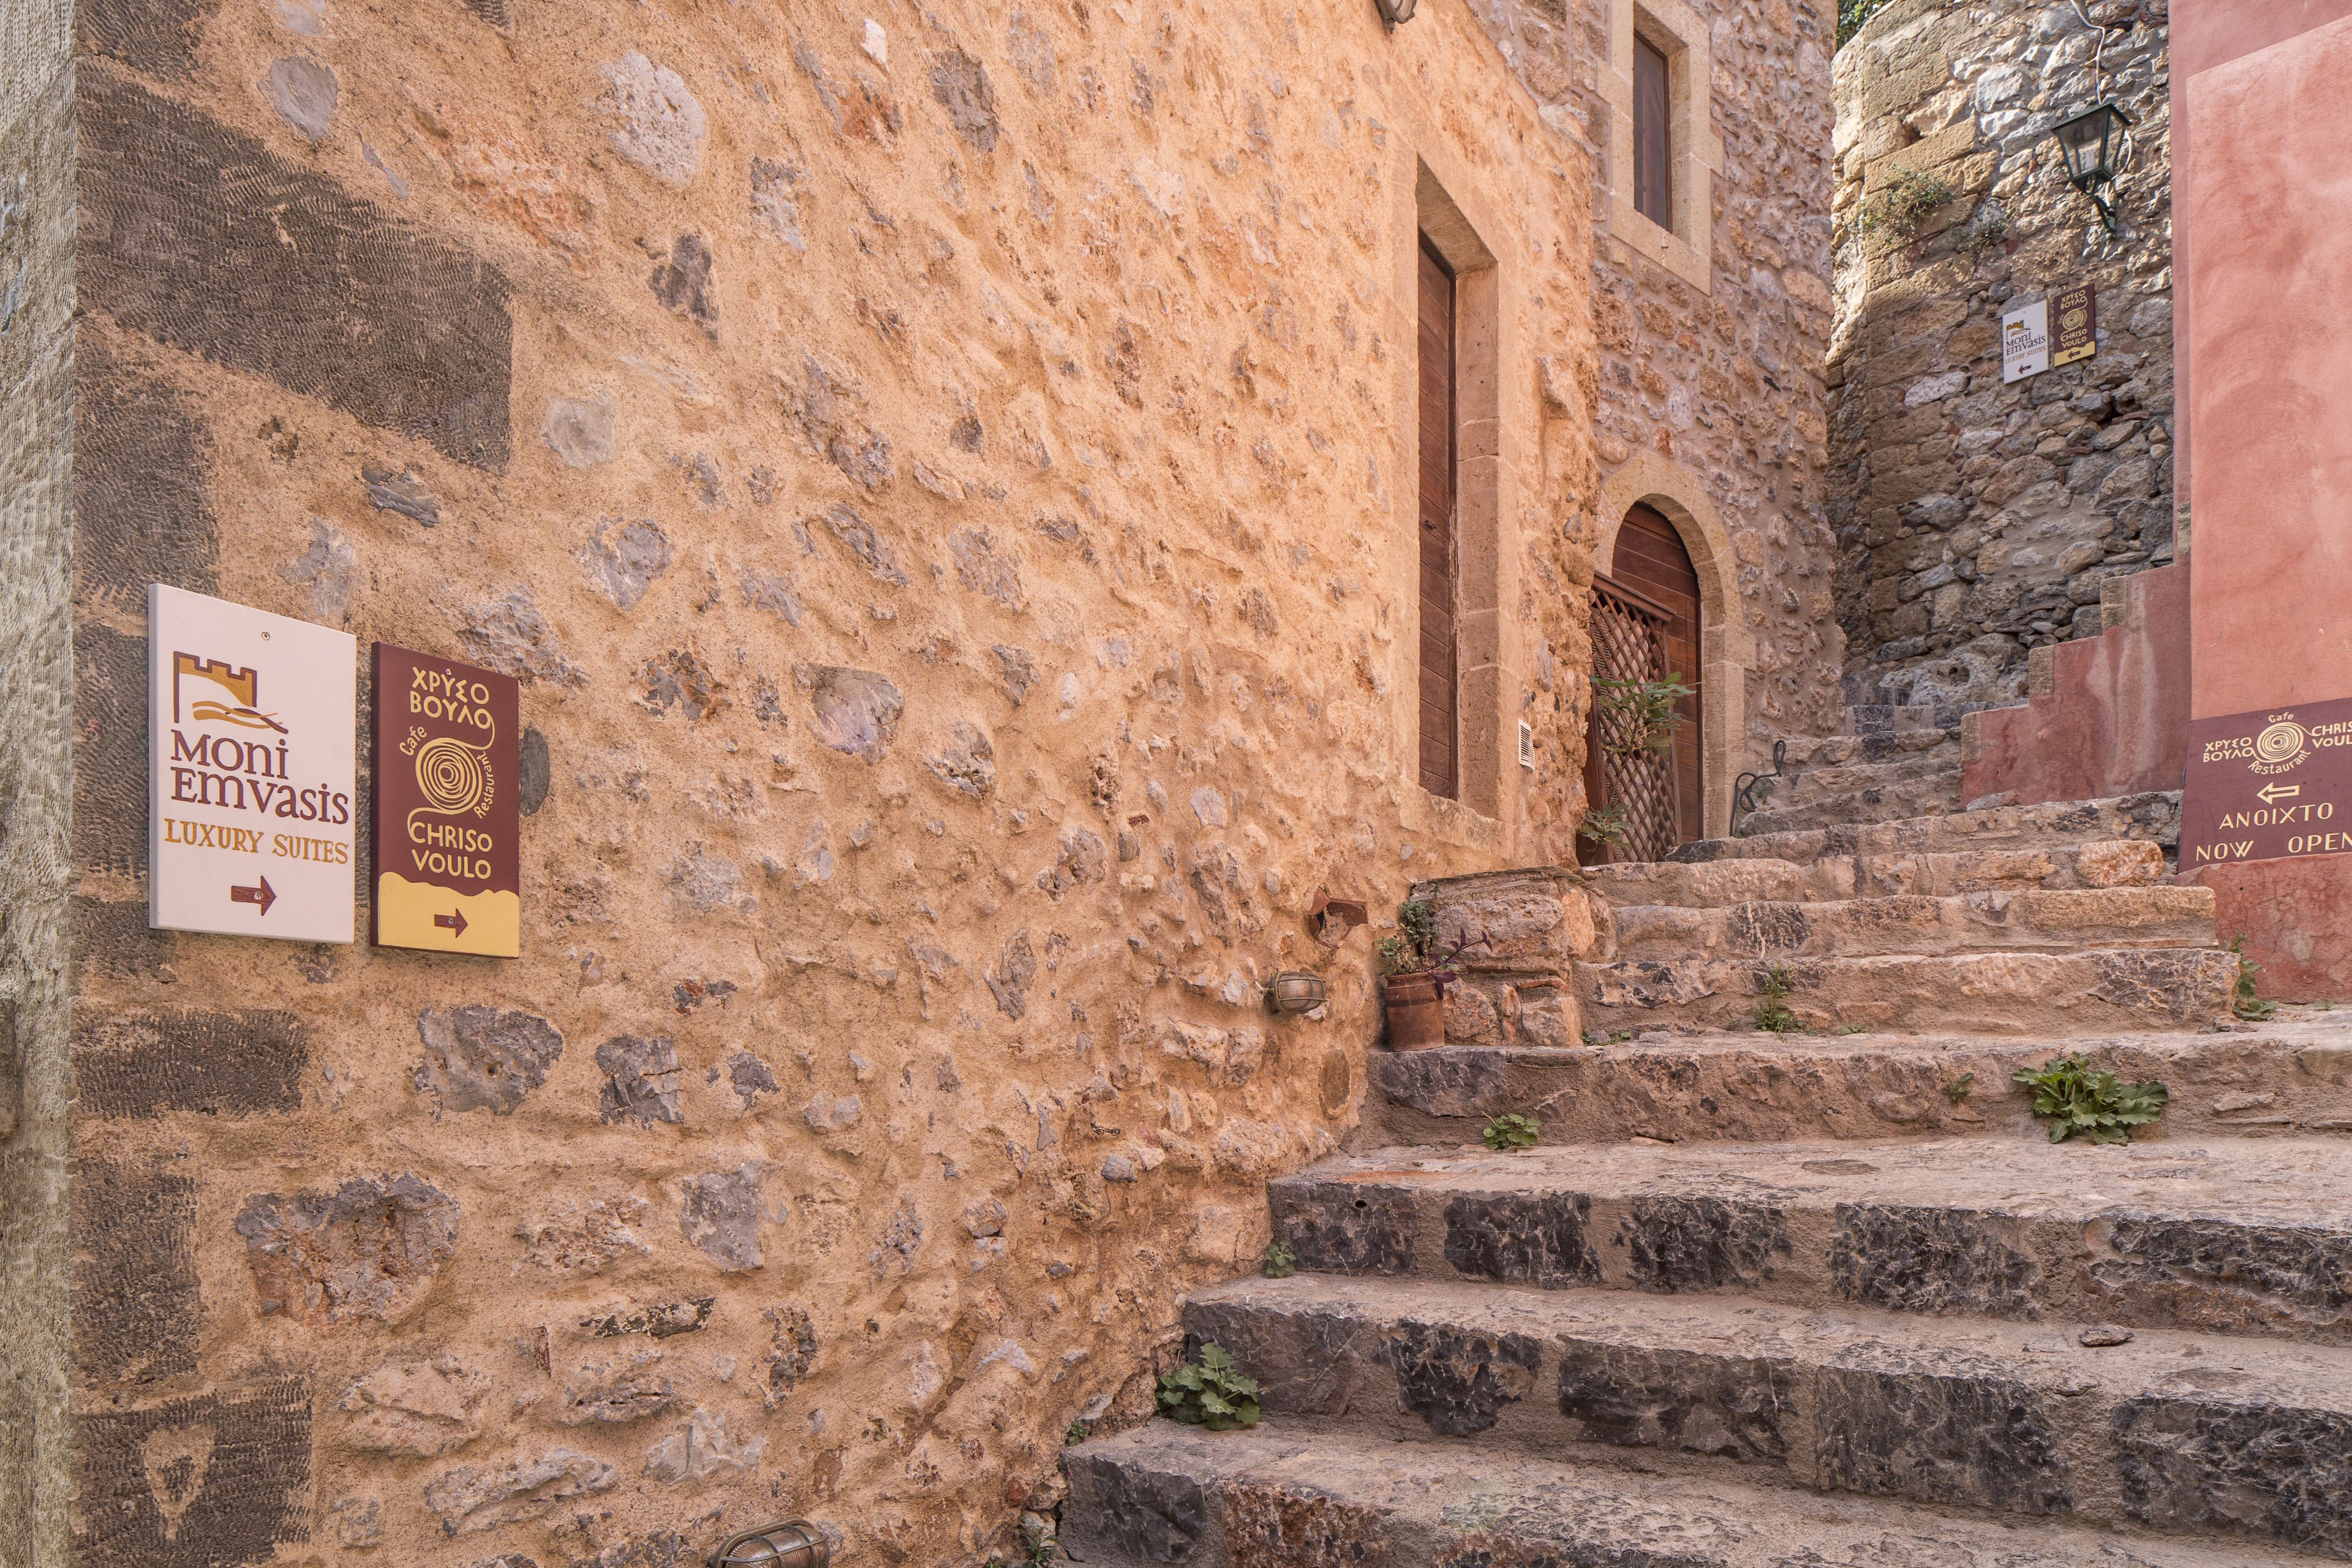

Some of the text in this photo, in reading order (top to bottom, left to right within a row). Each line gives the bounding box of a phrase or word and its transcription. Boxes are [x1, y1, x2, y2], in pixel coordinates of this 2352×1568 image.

[2006, 331, 2031, 349] Moni
[2006, 335, 2046, 355] Emvasis
[2061, 329, 2087, 342] CHRISO
[2062, 336, 2087, 348] VOULO
[2005, 345, 2046, 364] LUXURY SUITES
[412, 666, 489, 704] ΧΡΥΣΟ
[410, 690, 492, 729] ΒΟΥΛΟ
[2268, 711, 2294, 723] Cafe
[170, 728, 289, 780] Moni
[399, 726, 427, 756] Cafe
[2203, 747, 2253, 763] ΒΟΥΛΟ
[2204, 737, 2252, 752] ΧΡΥΣΟ
[2247, 748, 2312, 775] Restaurant
[170, 766, 349, 825] Emvasis
[473, 750, 495, 819] Restaurant
[164, 818, 349, 864] LUXURY SUITES
[410, 821, 493, 853] CHRISO
[2195, 832, 2352, 862] NOW OPEN
[411, 849, 491, 880] VOULO
